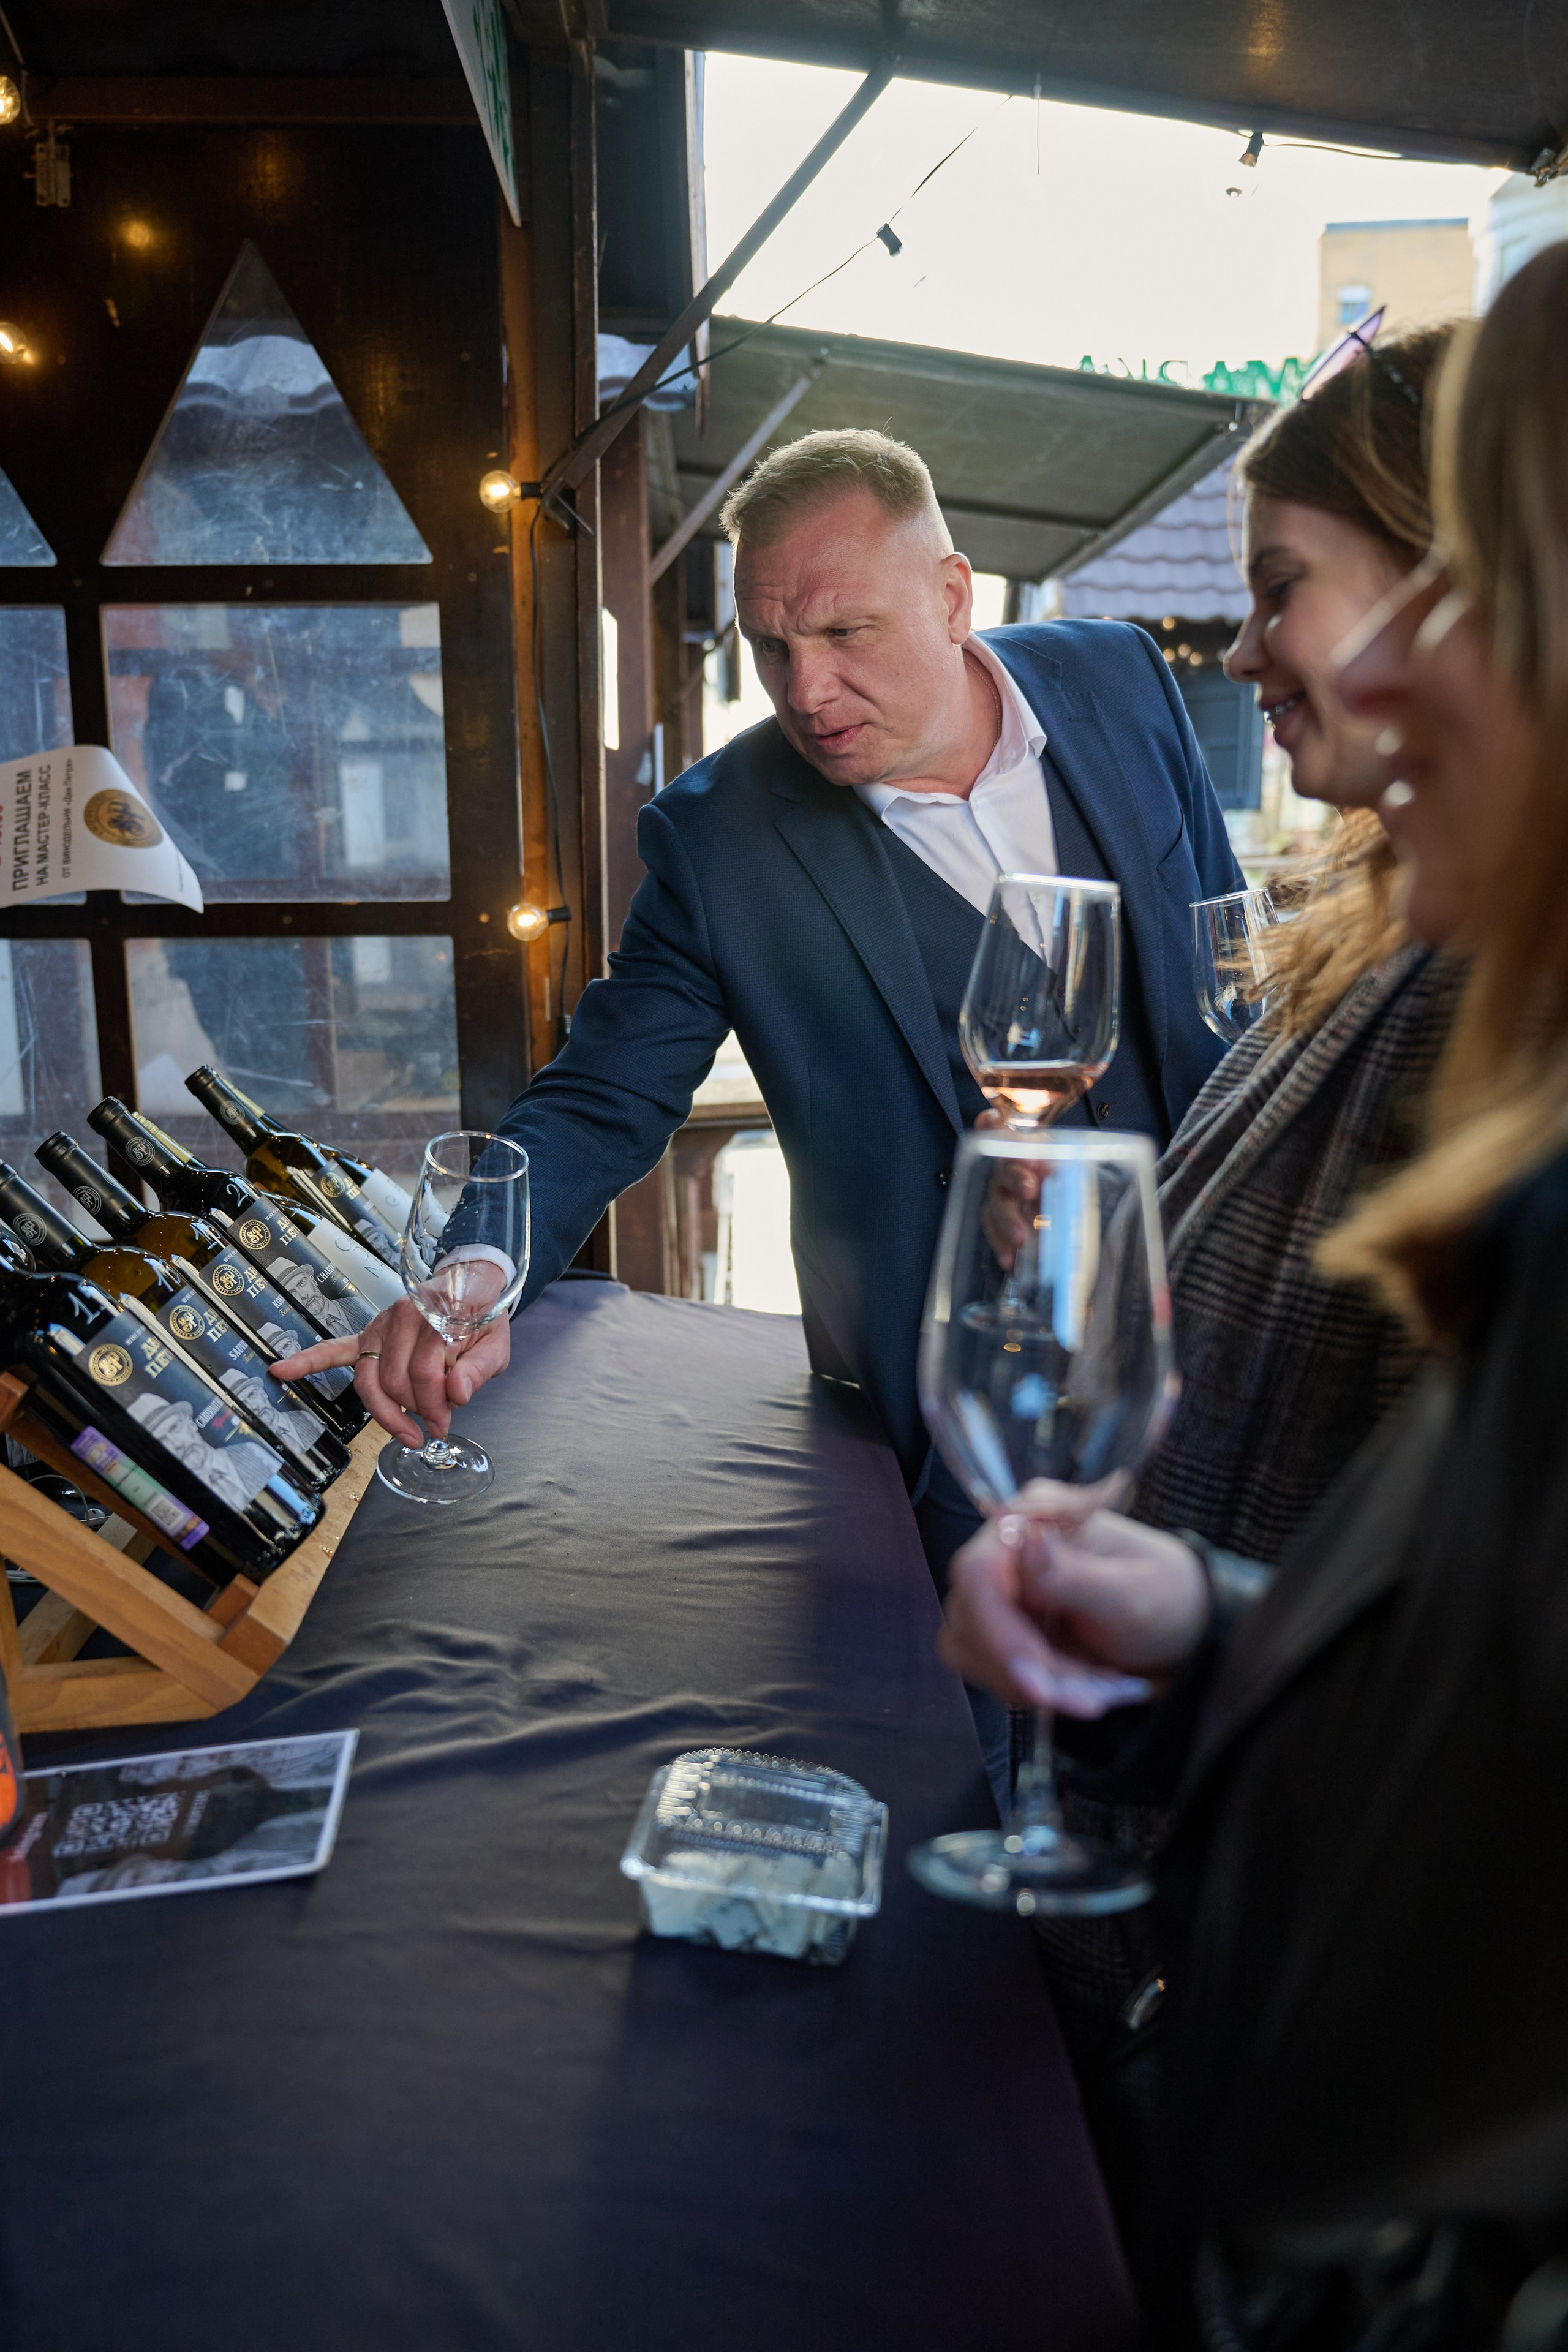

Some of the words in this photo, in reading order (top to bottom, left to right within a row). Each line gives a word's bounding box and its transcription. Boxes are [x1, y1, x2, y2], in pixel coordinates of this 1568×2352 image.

[12, 770, 31, 891] ПРИГЛАШАЕМ
[37, 764, 51, 864] МАСТЕР-КЛАСС
[36, 865, 48, 886] НА
[277, 1216, 290, 1232] ДВ
